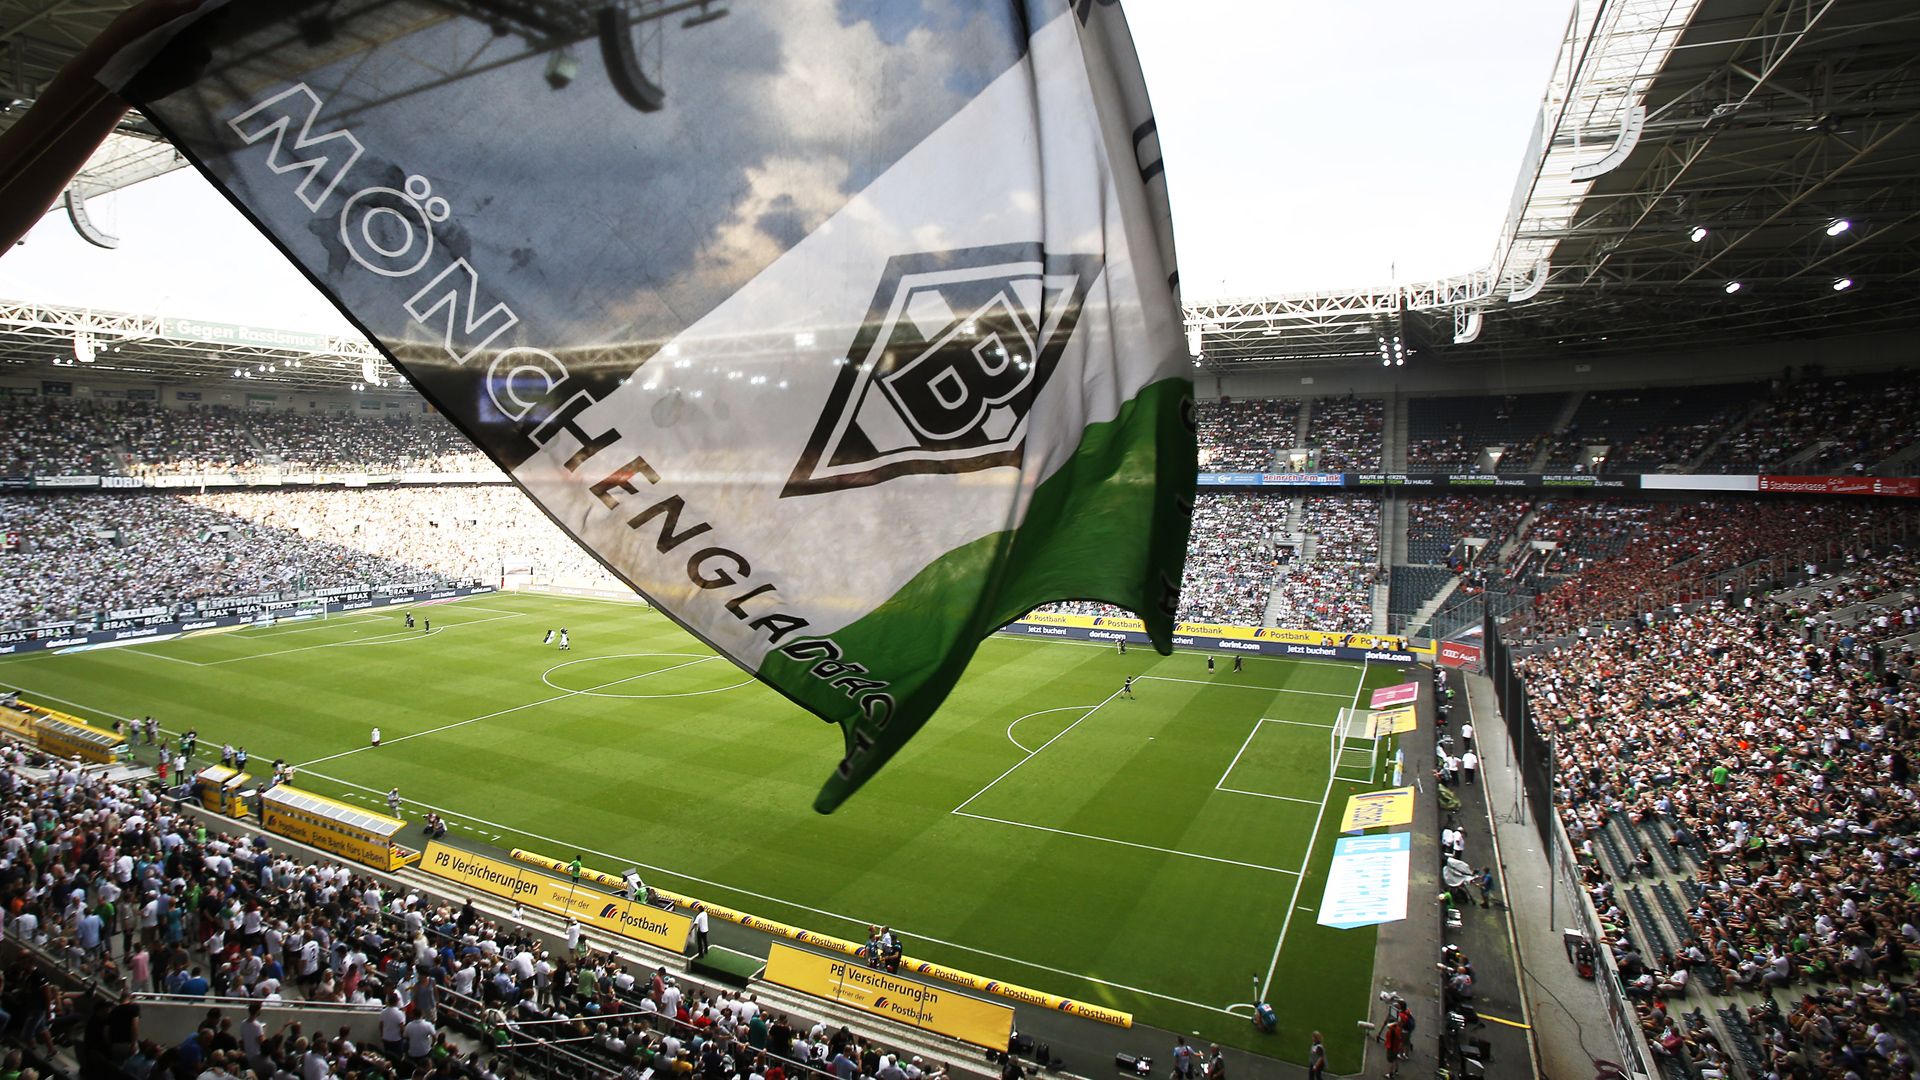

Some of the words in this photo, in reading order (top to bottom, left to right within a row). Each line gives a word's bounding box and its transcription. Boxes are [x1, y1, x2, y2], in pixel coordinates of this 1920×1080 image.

[177, 320, 233, 340] Gegen
[238, 326, 315, 346] Rassismus
[102, 477, 143, 488] NORD
[1263, 474, 1298, 482] Heinrich
[1770, 481, 1827, 492] Stadtsparkasse
[347, 592, 368, 601] BRAX
[202, 607, 228, 618] BRAX
[236, 603, 262, 614] BRAX
[144, 615, 173, 625] BRAX
[1034, 614, 1067, 623] Postbank
[1107, 619, 1142, 629] Postbank
[103, 619, 132, 630] BRAX
[1186, 625, 1223, 634] Postbank
[37, 626, 70, 638] BRAX
[1043, 626, 1067, 635] buchen!
[1089, 630, 1127, 640] dorint.com
[1270, 631, 1310, 641] Postbank
[0, 632, 26, 642] RAX
[1219, 640, 1260, 650] dorint.com
[1287, 645, 1305, 653] Jetzt
[1306, 647, 1336, 656] buchen!
[1366, 652, 1412, 662] dorint.com
[1460, 653, 1477, 662] Audi
[328, 837, 345, 850] Bank
[345, 842, 361, 857] fürs
[362, 848, 386, 864] Leben.
[523, 855, 548, 867] Postbank
[435, 851, 450, 866] PB
[452, 856, 538, 895] Versicherungen
[552, 892, 576, 905] Partner
[577, 898, 590, 910] der
[703, 904, 735, 920] Postbank
[620, 911, 669, 937] Postbank
[754, 919, 788, 936] Postbank
[811, 935, 847, 951] Postbank
[830, 963, 845, 977] PB
[848, 967, 938, 1003] Versicherungen
[934, 968, 975, 987] Postbank
[832, 985, 854, 998] Partner
[855, 991, 865, 1001] der
[1003, 986, 1047, 1005] Postbank
[891, 1002, 934, 1023] Postbank
[1078, 1005, 1125, 1026] Postbank
